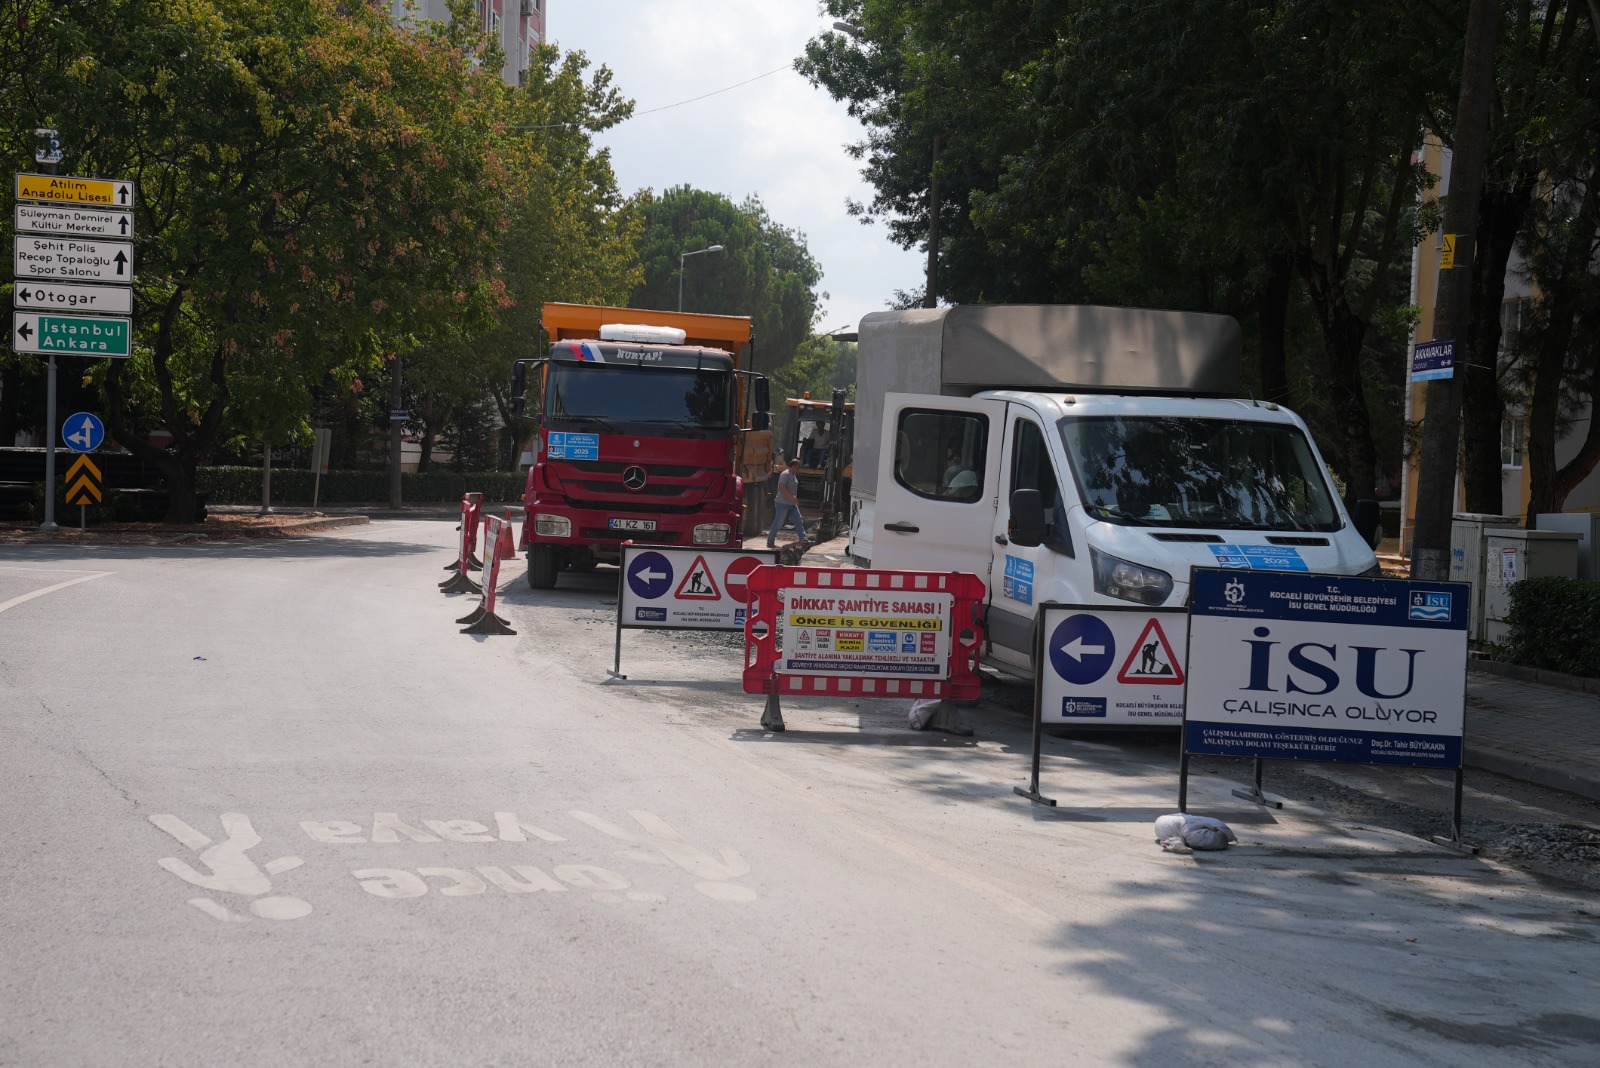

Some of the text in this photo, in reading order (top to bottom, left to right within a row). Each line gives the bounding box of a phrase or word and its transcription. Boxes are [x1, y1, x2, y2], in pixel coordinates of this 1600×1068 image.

[50, 180, 87, 190] Atılım
[22, 188, 111, 203] Anadolu Lisesi
[20, 209, 113, 223] Süleyman Demirel
[32, 220, 105, 233] Kültür Merkezi
[34, 240, 96, 253] Şehit Polis
[19, 252, 110, 266] Recep Topaloğlu
[30, 264, 100, 277] Spor Salonu
[35, 290, 97, 306] Otogar
[44, 318, 121, 337] İstanbul
[43, 336, 107, 350] Ankara
[1414, 344, 1452, 361] AKKAVAKLAR
[614, 519, 654, 530] 41 KZ 161
[1327, 586, 1340, 594] T.C.
[790, 596, 836, 611] DİKKAT
[838, 598, 889, 614] ŞANTİYE
[892, 600, 935, 614] SAHASI
[1270, 590, 1397, 606] KOCAELİ BÜYÜKŞEHİR BELEDİYESİ
[1427, 593, 1450, 607] İSU
[1288, 601, 1377, 613] İSU GENEL MÜDÜRLÜĞÜ
[796, 616, 937, 629] ÖNCE İŞ GÜVENLİĞİ
[794, 652, 817, 660] ŞANTİYE
[1238, 626, 1426, 700] İSU
[1223, 699, 1438, 724] ÇALIŞINCA OLUYOR
[1202, 729, 1363, 745] ÇALIŞMALARIMIZDA GÖSTERMİŞ OLDUĞUNUZ
[1202, 738, 1337, 752] ANLAYIŞTAN DOLAYI TEŞEKKÜR EDERİZ
[1394, 740, 1408, 749] Tahir
[1409, 740, 1446, 751] BÜYÜKAKIN
